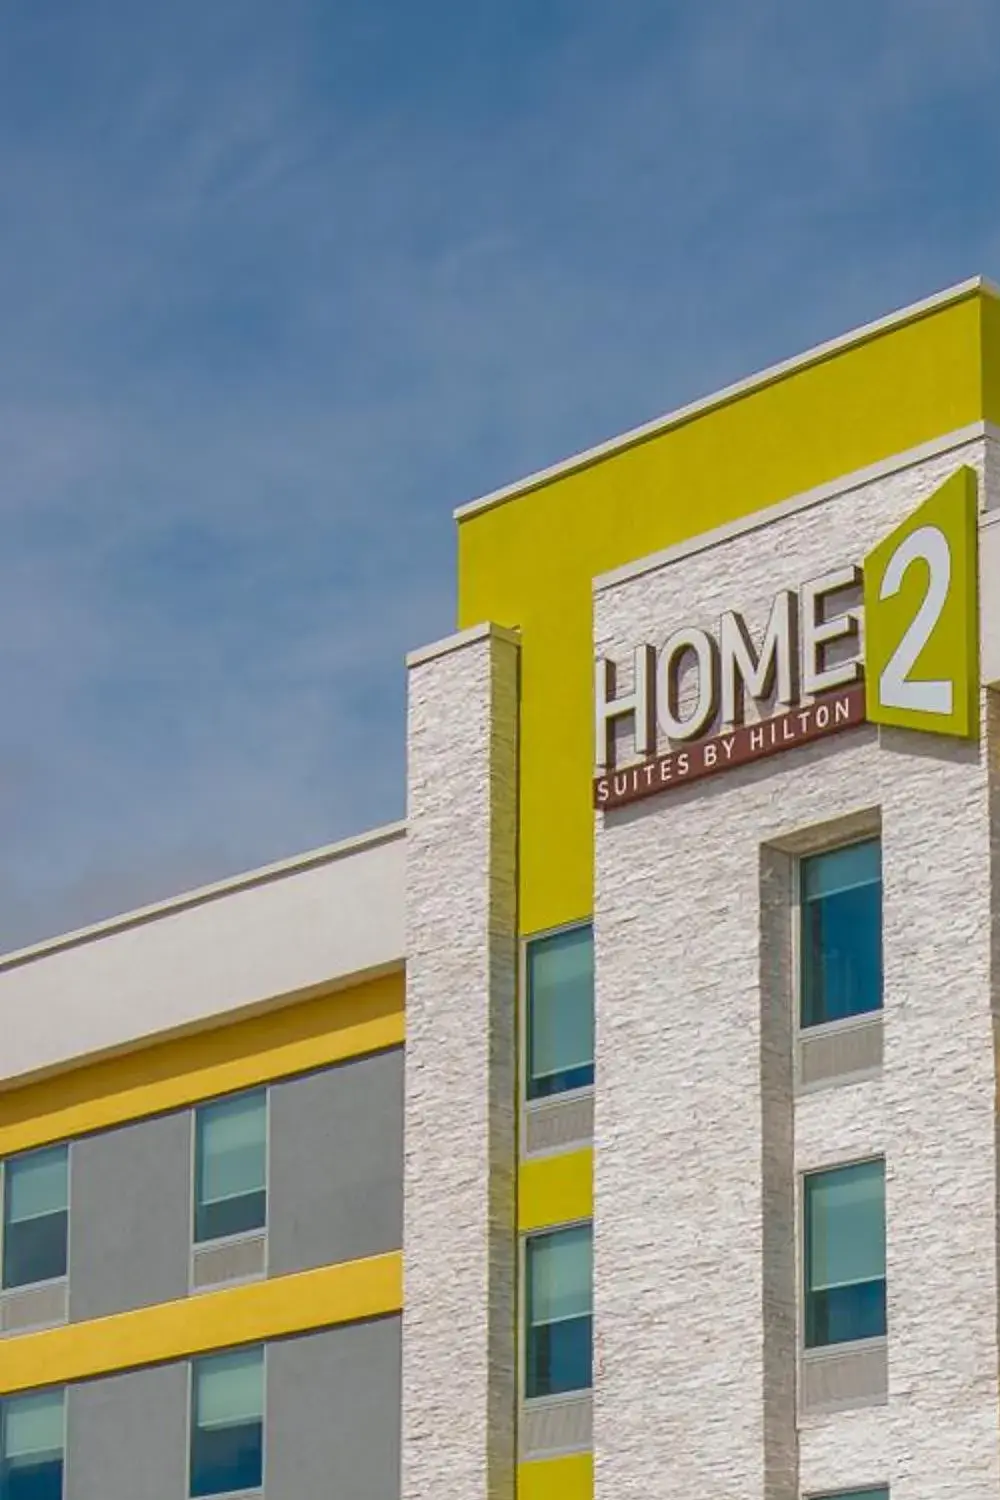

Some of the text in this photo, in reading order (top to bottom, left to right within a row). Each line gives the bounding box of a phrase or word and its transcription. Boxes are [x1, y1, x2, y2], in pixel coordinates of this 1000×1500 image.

[594, 525, 952, 768] HOME 2
[597, 698, 850, 801] SUITES BY HILTON
